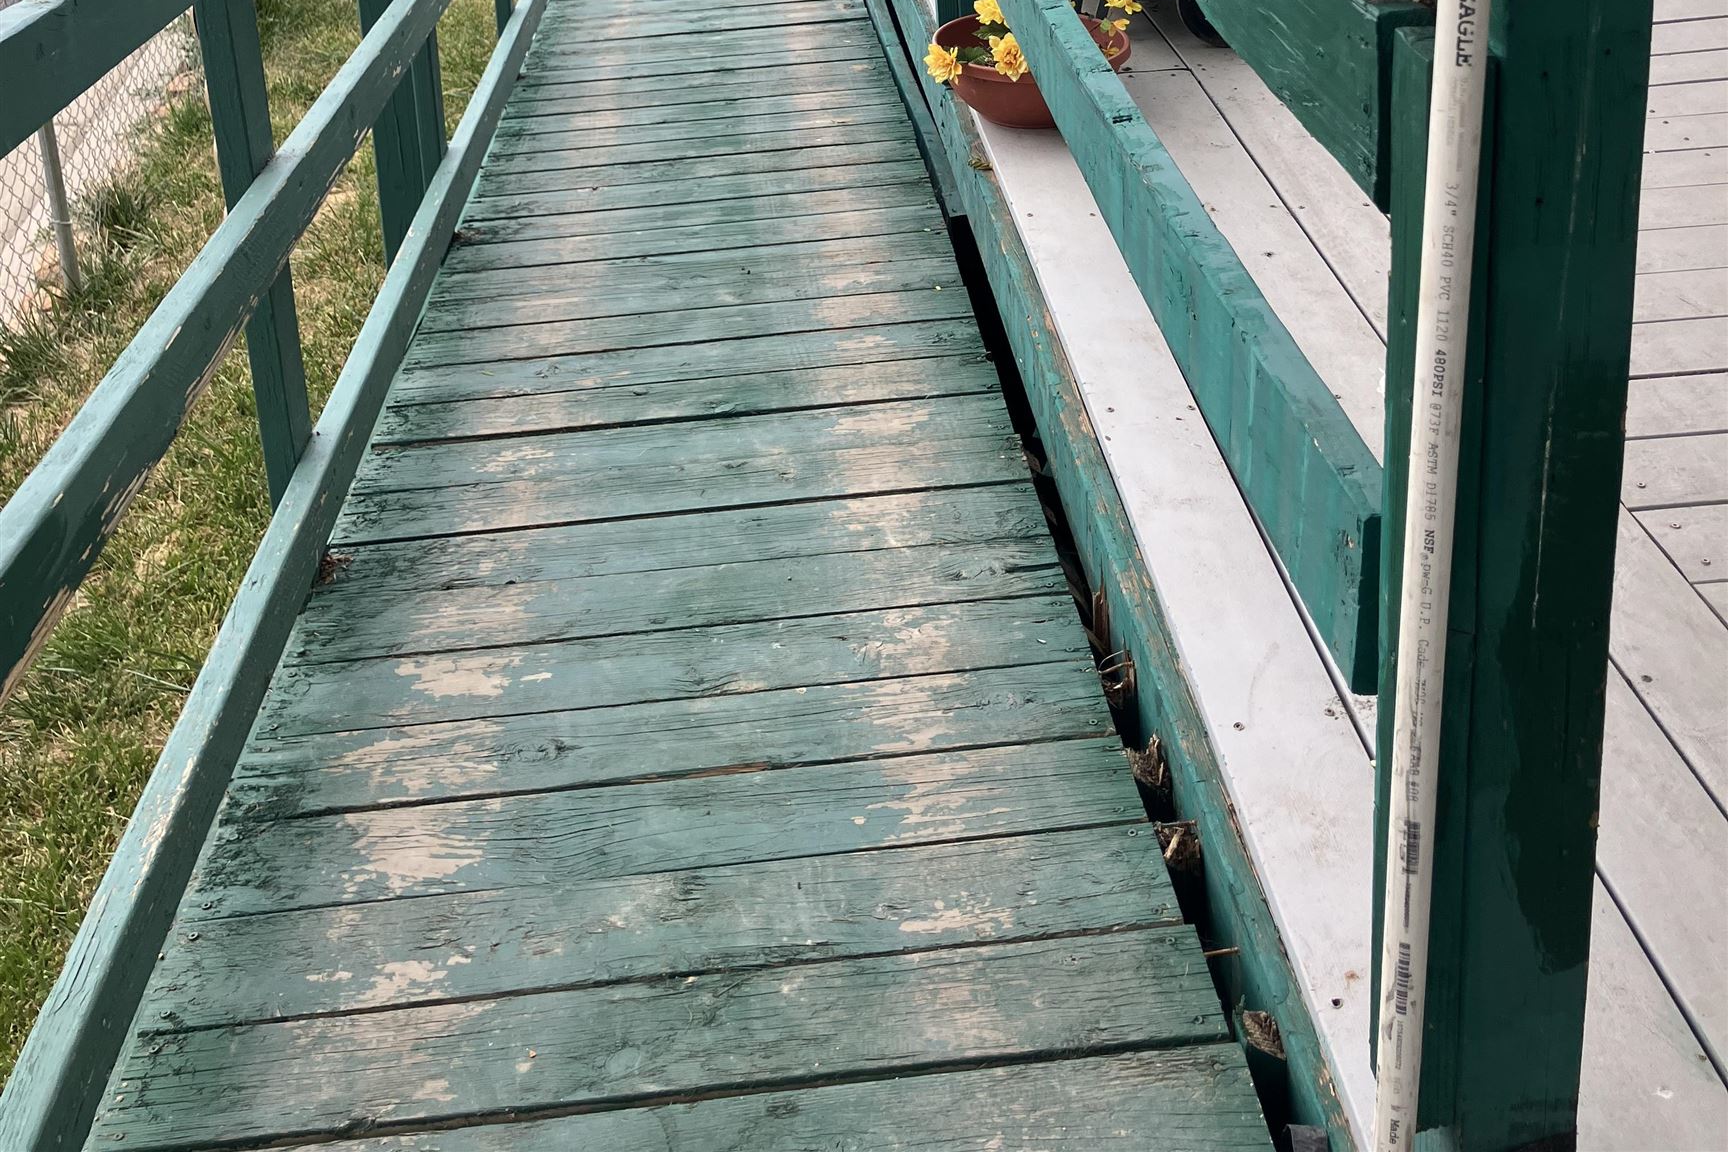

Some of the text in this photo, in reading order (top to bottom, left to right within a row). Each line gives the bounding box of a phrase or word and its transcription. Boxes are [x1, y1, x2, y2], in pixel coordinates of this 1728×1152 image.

[1441, 226, 1456, 266] SCH40
[1439, 276, 1452, 300] PVC
[1436, 310, 1450, 341] 1120
[1427, 443, 1439, 475] ASTM
[1424, 483, 1437, 521] D1785
